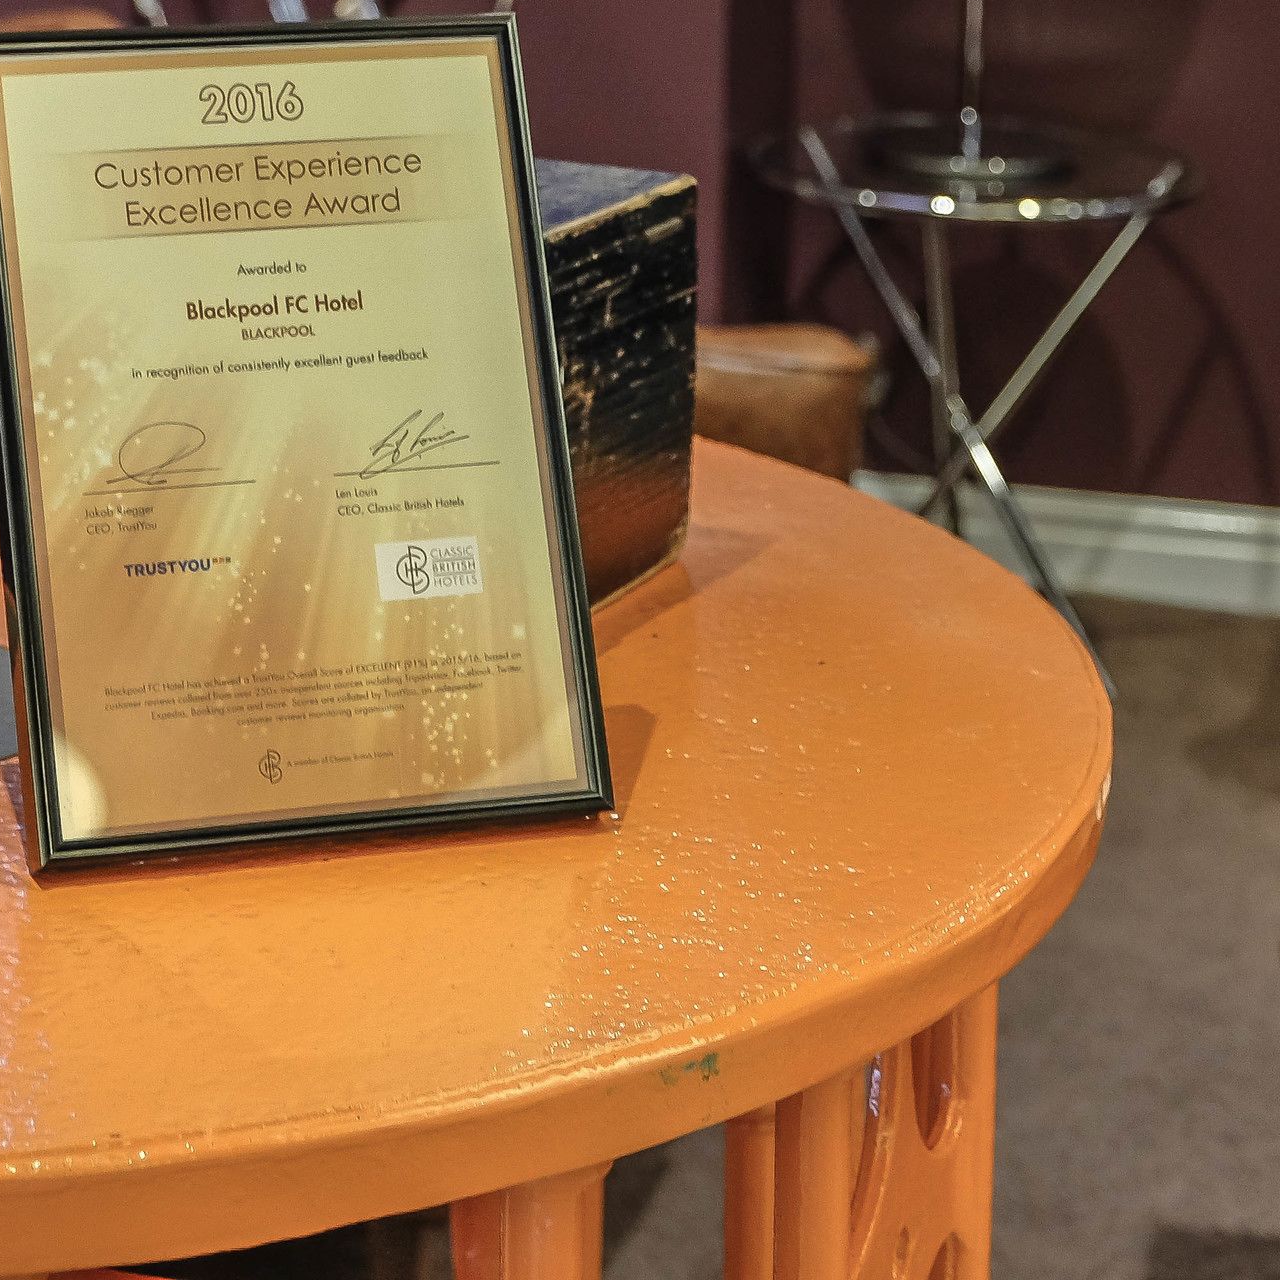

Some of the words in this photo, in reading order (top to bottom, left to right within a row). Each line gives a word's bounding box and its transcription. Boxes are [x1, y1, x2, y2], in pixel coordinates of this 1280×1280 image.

[198, 79, 305, 125] 2016
[94, 160, 244, 190] Customer
[253, 150, 422, 185] Experience
[125, 196, 293, 227] Excellence
[304, 186, 401, 218] Award
[237, 261, 291, 277] Awarded
[295, 261, 307, 274] to
[186, 294, 279, 322] Blackpool
[285, 295, 309, 314] FC
[314, 290, 364, 313] Hotel
[241, 324, 316, 341] BLACKPOOL
[131, 368, 142, 379] in
[146, 363, 209, 380] recognition
[212, 360, 225, 375] of
[227, 355, 291, 373] consistently
[294, 353, 343, 369] excellent
[345, 351, 376, 369] guest
[377, 346, 429, 363] feedback
[335, 488, 352, 499] Len
[354, 485, 378, 498] Louis
[337, 504, 365, 517] CEO,
[367, 502, 401, 515] Classic
[404, 498, 433, 511] British
[435, 496, 465, 508] Hotels
[429, 545, 474, 559] CLASSIC
[123, 558, 212, 577] TRUSTYOU
[431, 559, 477, 573] BRITISH
[433, 575, 478, 588] HOTELS
